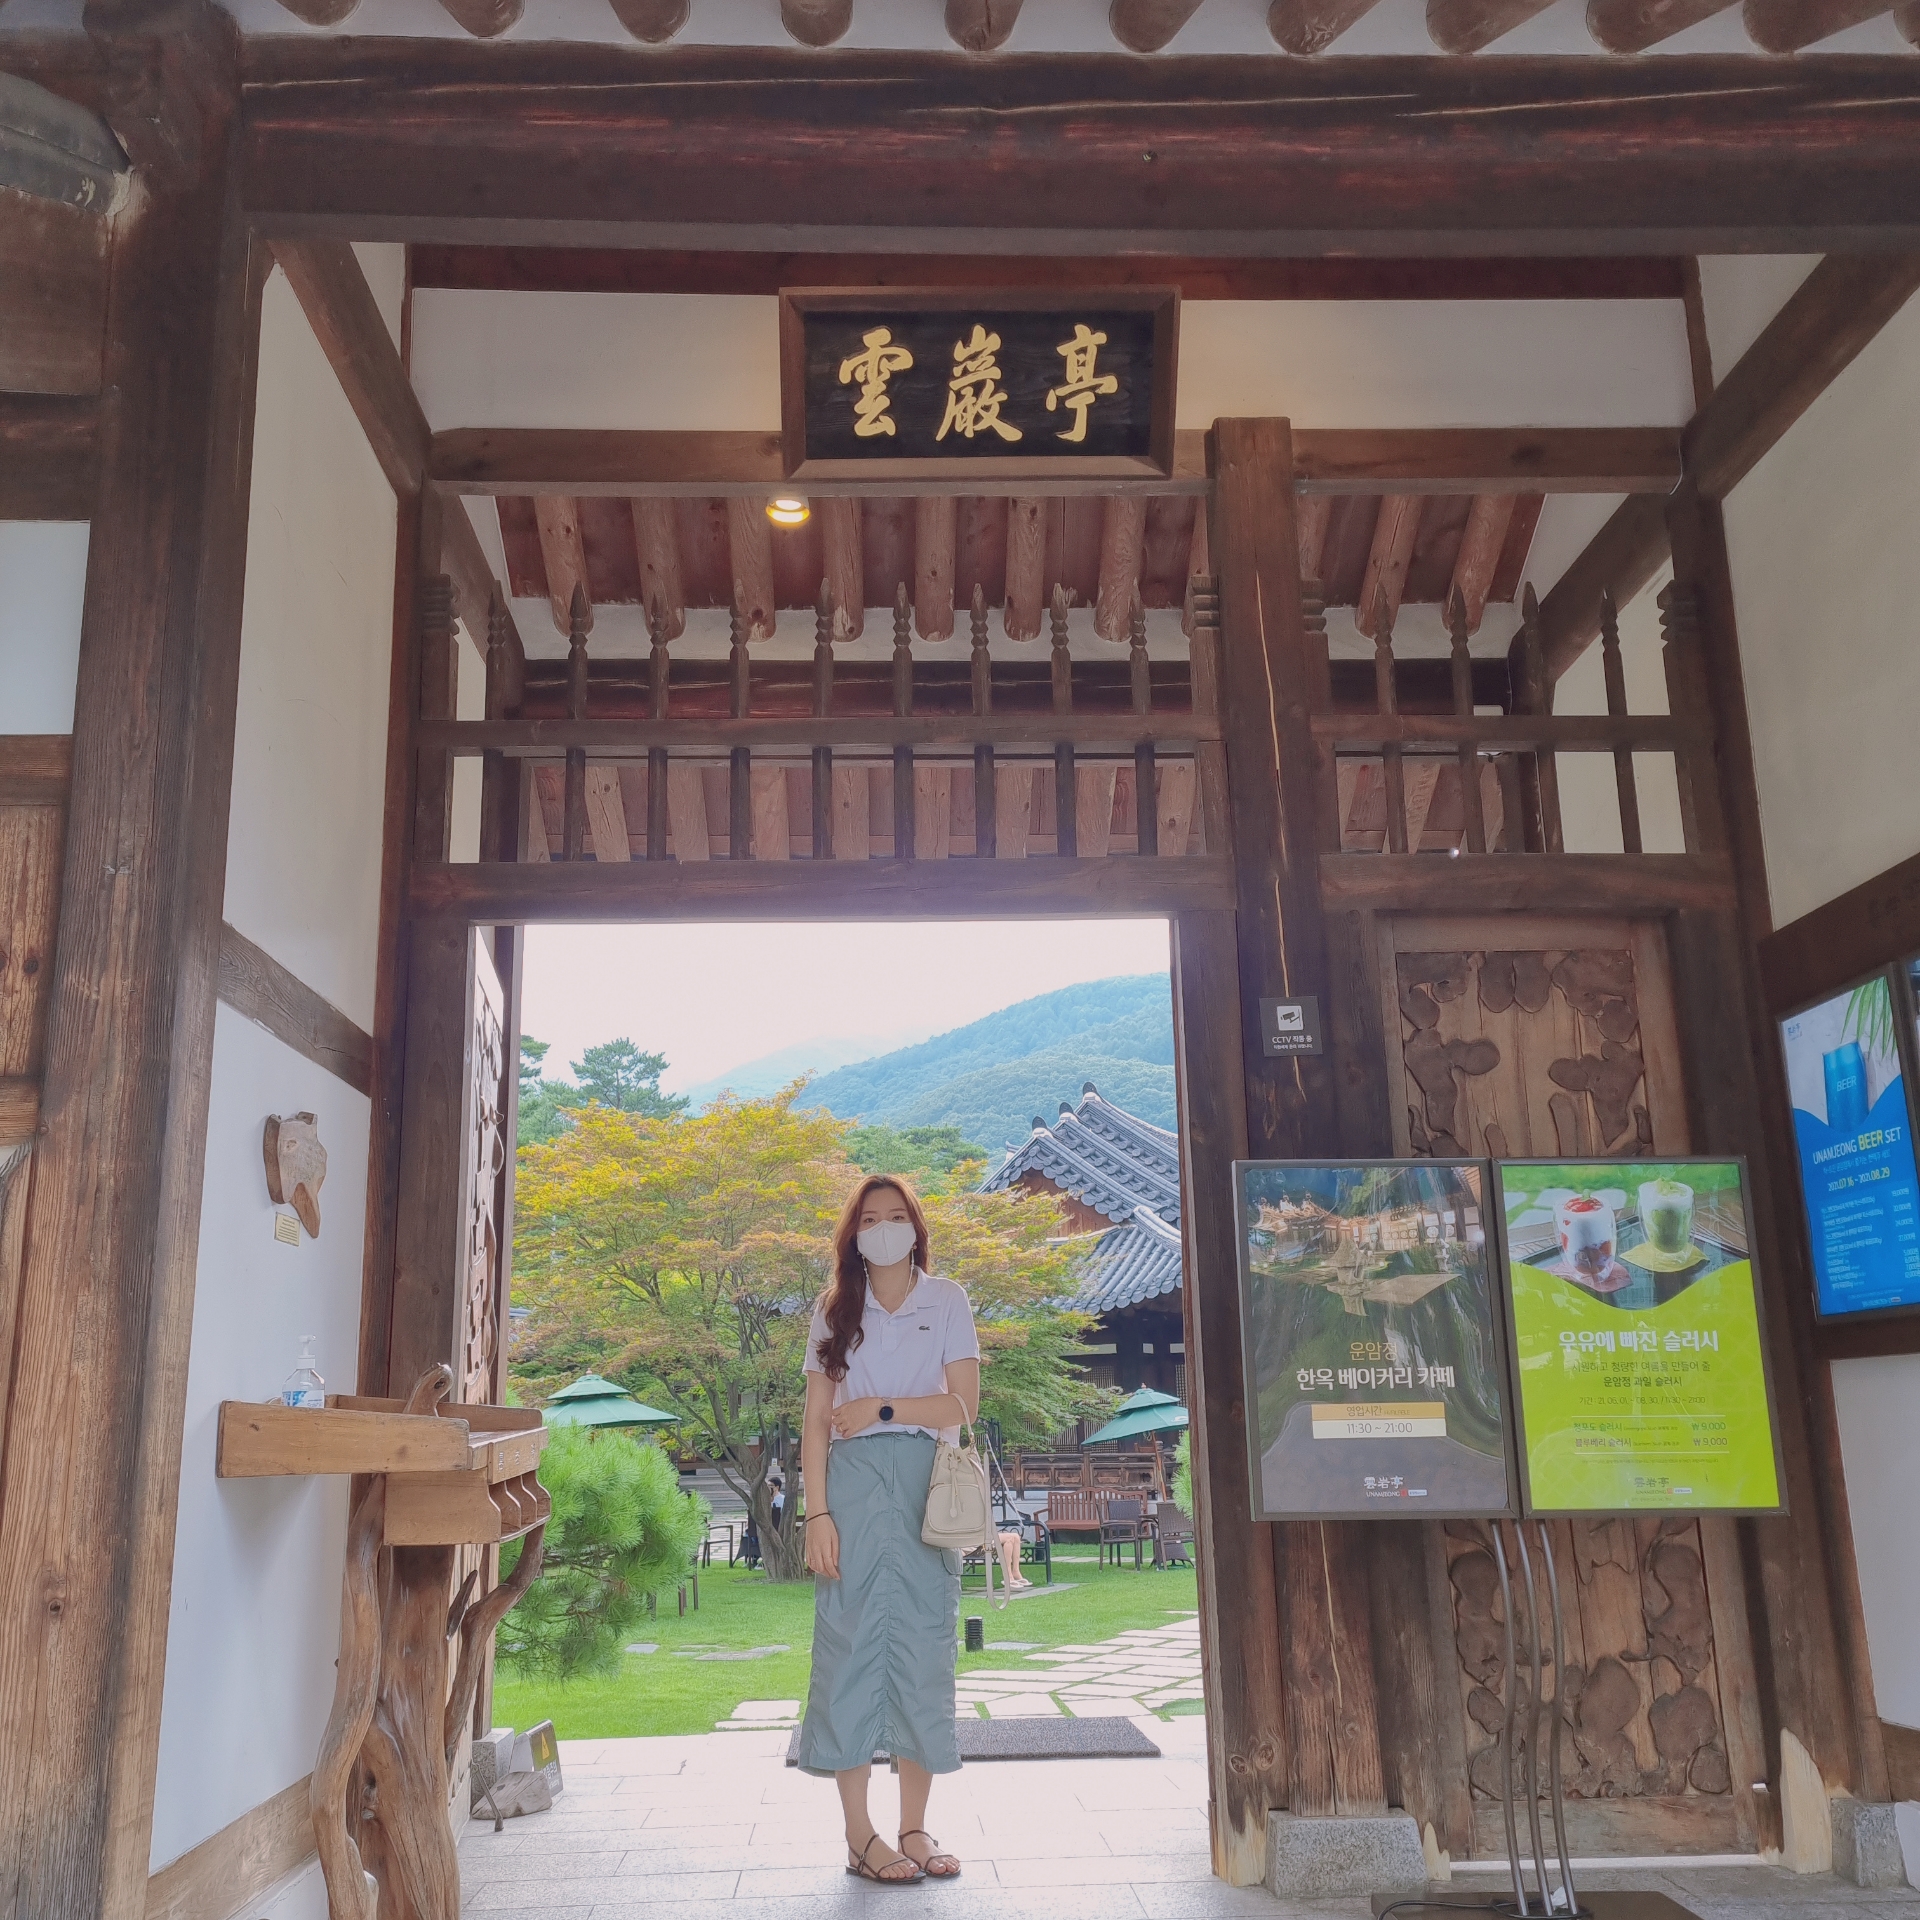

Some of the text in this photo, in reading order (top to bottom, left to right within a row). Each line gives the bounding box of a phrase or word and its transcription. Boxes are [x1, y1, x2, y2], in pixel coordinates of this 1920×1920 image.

[838, 323, 1119, 442] 雲巖亭
[1836, 1075, 1857, 1092] BEER
[1812, 1139, 1857, 1165] UNAMJEONG
[1858, 1129, 1884, 1151] BEER
[1884, 1126, 1901, 1144] SET
[1559, 1330, 1719, 1353] 우유에 빠진 슬러시
[1350, 1342, 1398, 1361] 운암정
[1572, 1361, 1608, 1373] 시원하고
[1671, 1361, 1699, 1372] 만들어
[1296, 1365, 1455, 1391] 한옥 베이커리 카페
[1603, 1376, 1683, 1388] 운암정 과일 슬러시
[1346, 1405, 1382, 1417] 영업시간
[1346, 1423, 1372, 1434] 11:30
[1384, 1422, 1413, 1433] 21:00
[1573, 1422, 1597, 1432] 청포도
[1599, 1422, 1623, 1432] 슬러시
[1575, 1437, 1607, 1448] 블루베리
[1608, 1437, 1632, 1448] 슬러시
